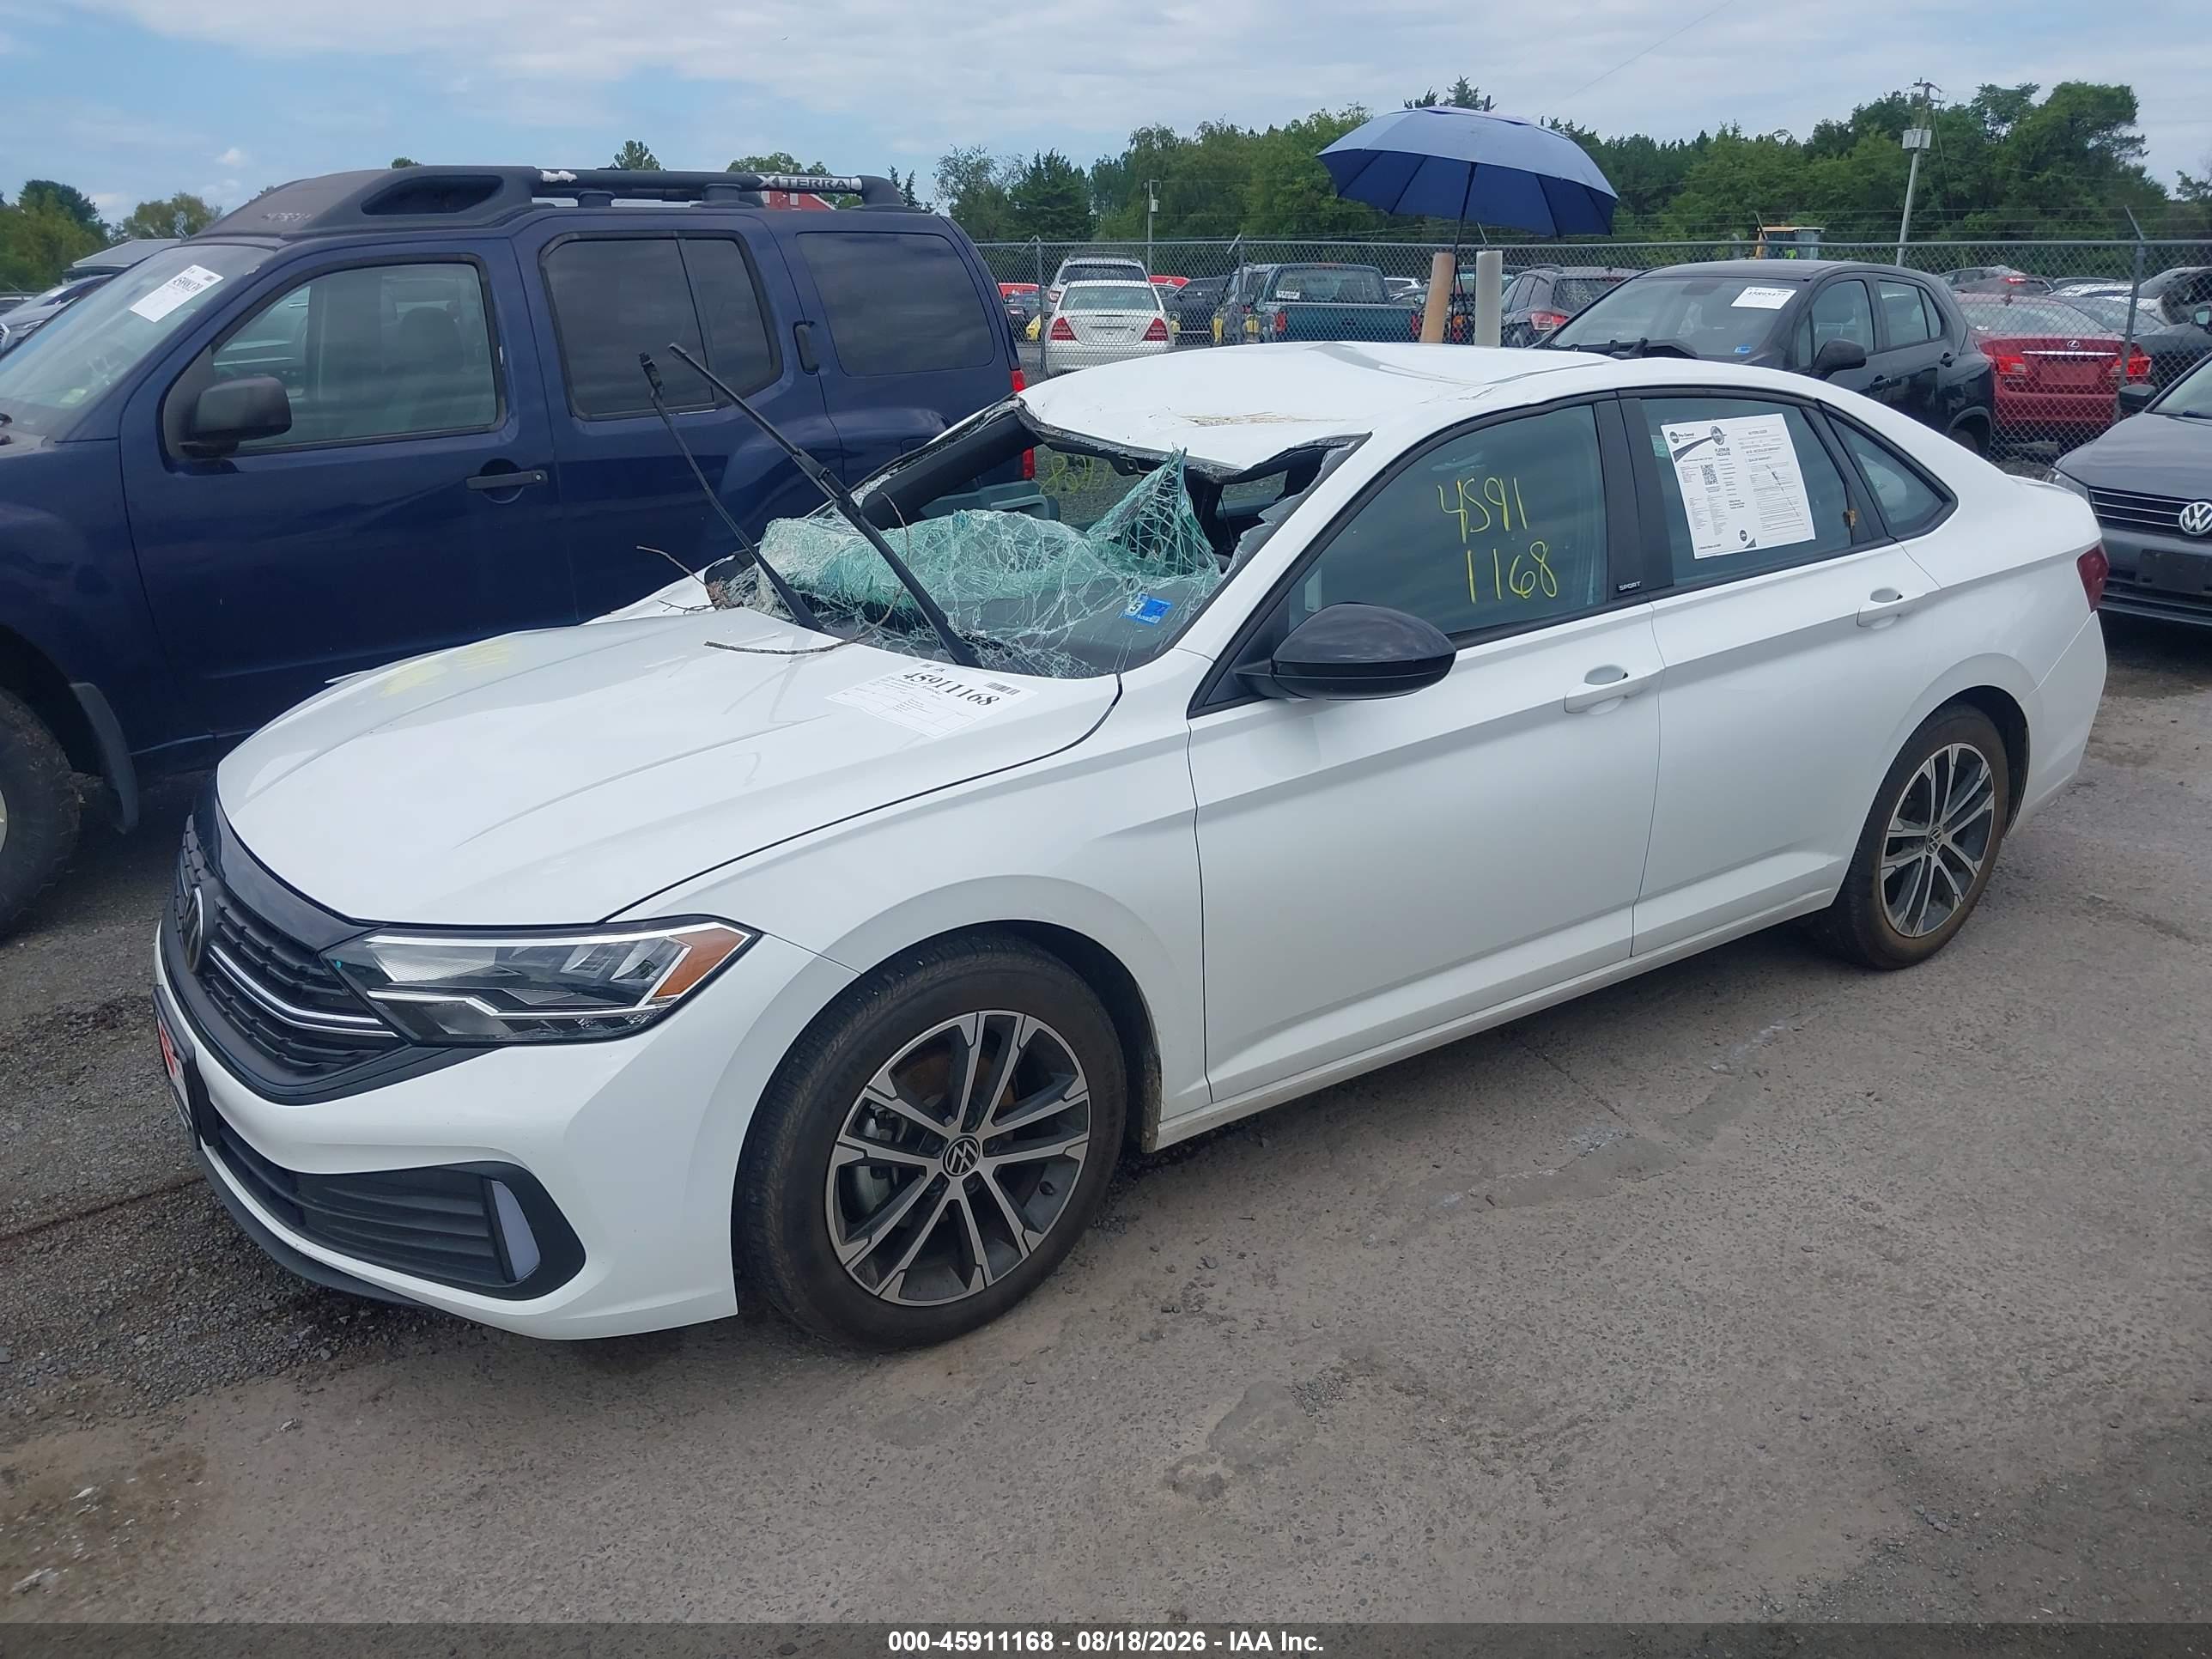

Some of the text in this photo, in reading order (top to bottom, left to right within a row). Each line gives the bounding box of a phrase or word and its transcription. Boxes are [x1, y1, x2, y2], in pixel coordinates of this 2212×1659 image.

[756, 174, 852, 189] XTERRA
[1437, 476, 1528, 544] 4591
[1467, 540, 1558, 604] 1168
[1619, 580, 1641, 592] SPORT
[902, 672, 1000, 706] 45911168
